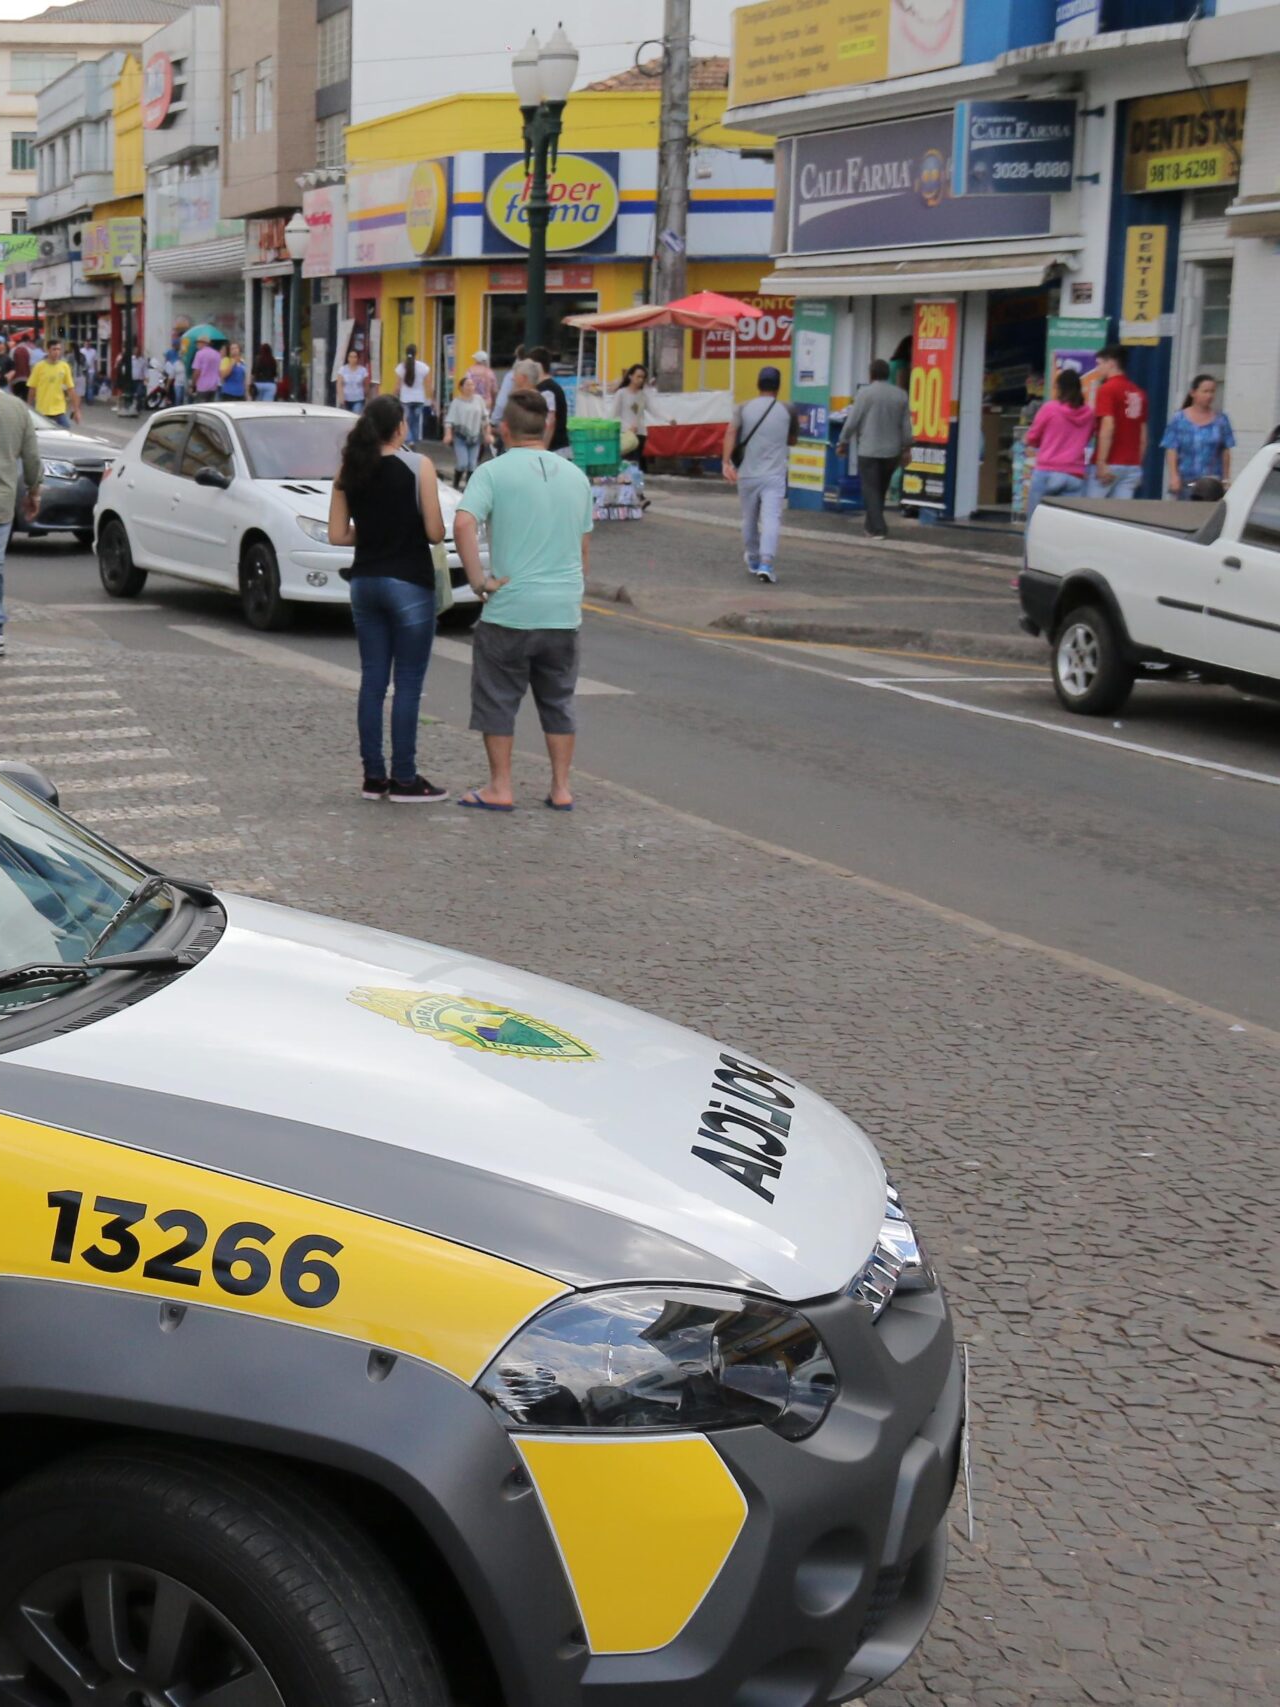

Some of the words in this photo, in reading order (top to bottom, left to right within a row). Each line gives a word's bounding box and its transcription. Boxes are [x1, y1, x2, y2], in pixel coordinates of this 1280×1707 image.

[505, 193, 601, 223] fama
[1134, 232, 1154, 321] DENTISTA
[47, 1189, 345, 1309] 13266
